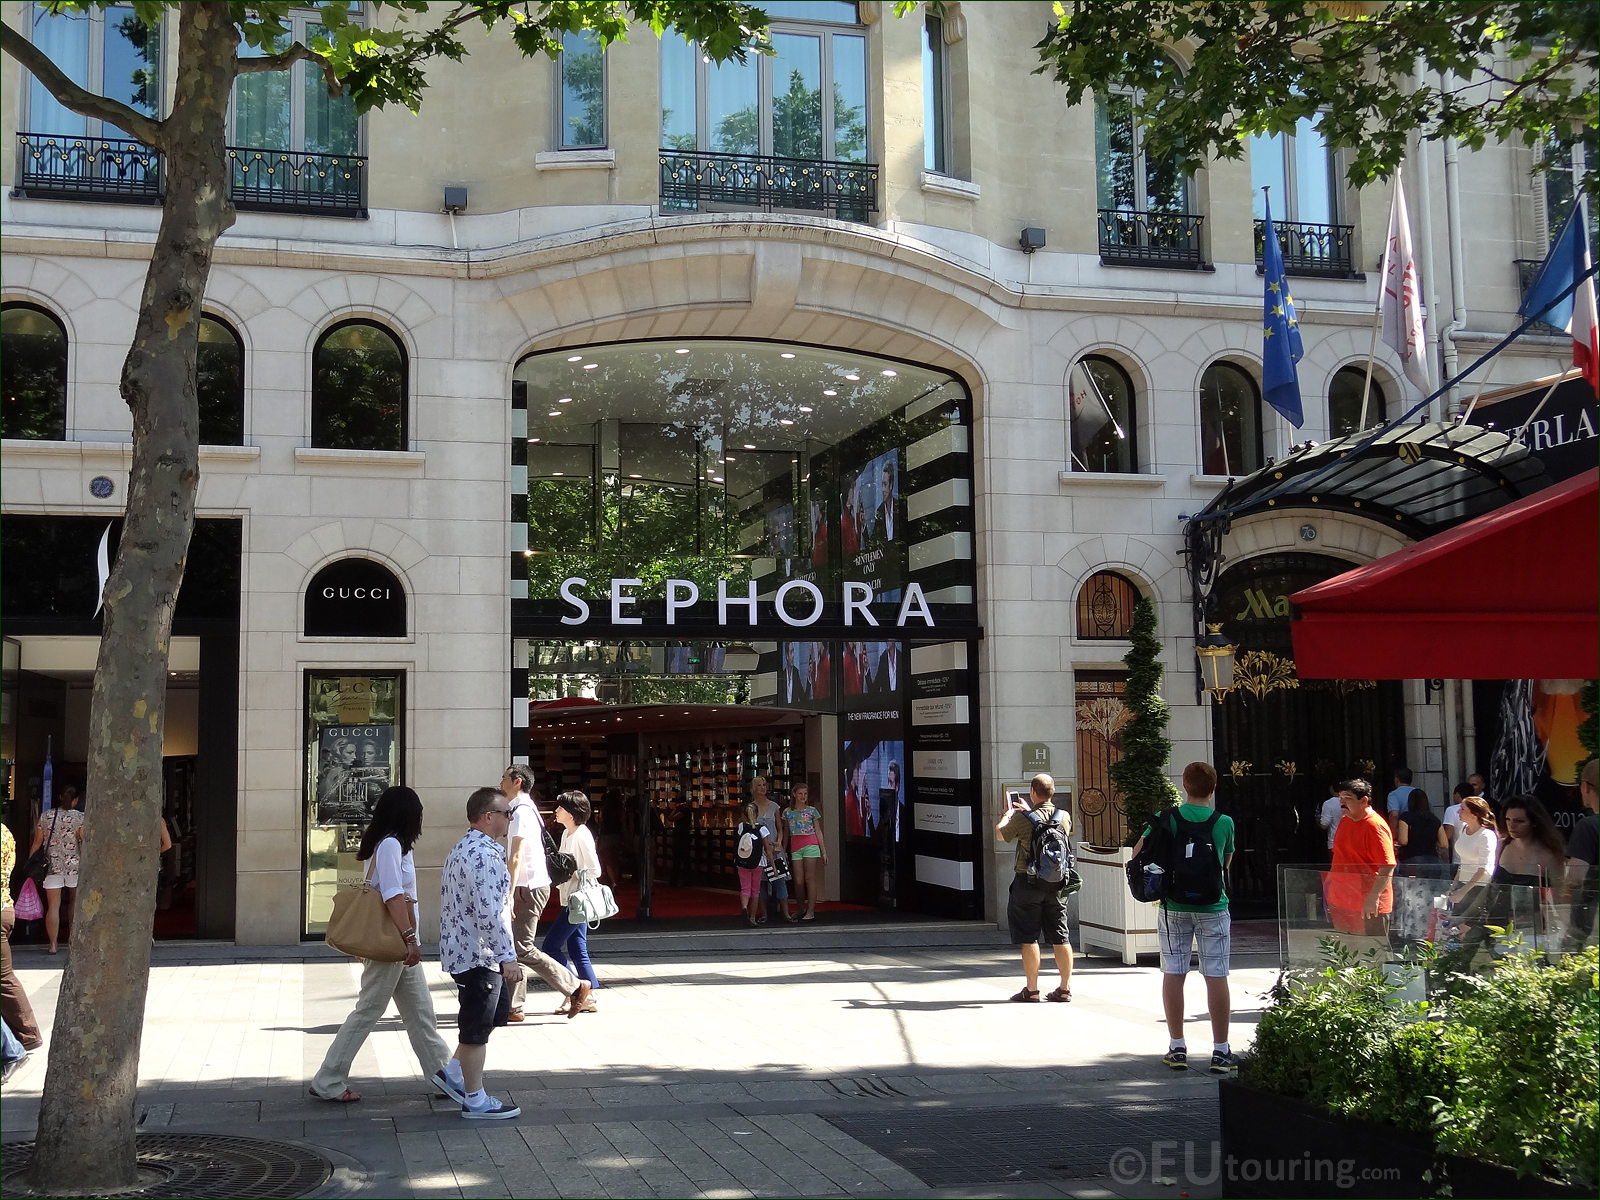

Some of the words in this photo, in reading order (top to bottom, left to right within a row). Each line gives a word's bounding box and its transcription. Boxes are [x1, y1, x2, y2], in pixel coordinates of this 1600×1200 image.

[1301, 526, 1316, 539] 70
[323, 587, 390, 600] GUCCI
[560, 577, 935, 627] SEPHORA
[328, 728, 379, 737] GUCCI
[1035, 748, 1047, 760] H
